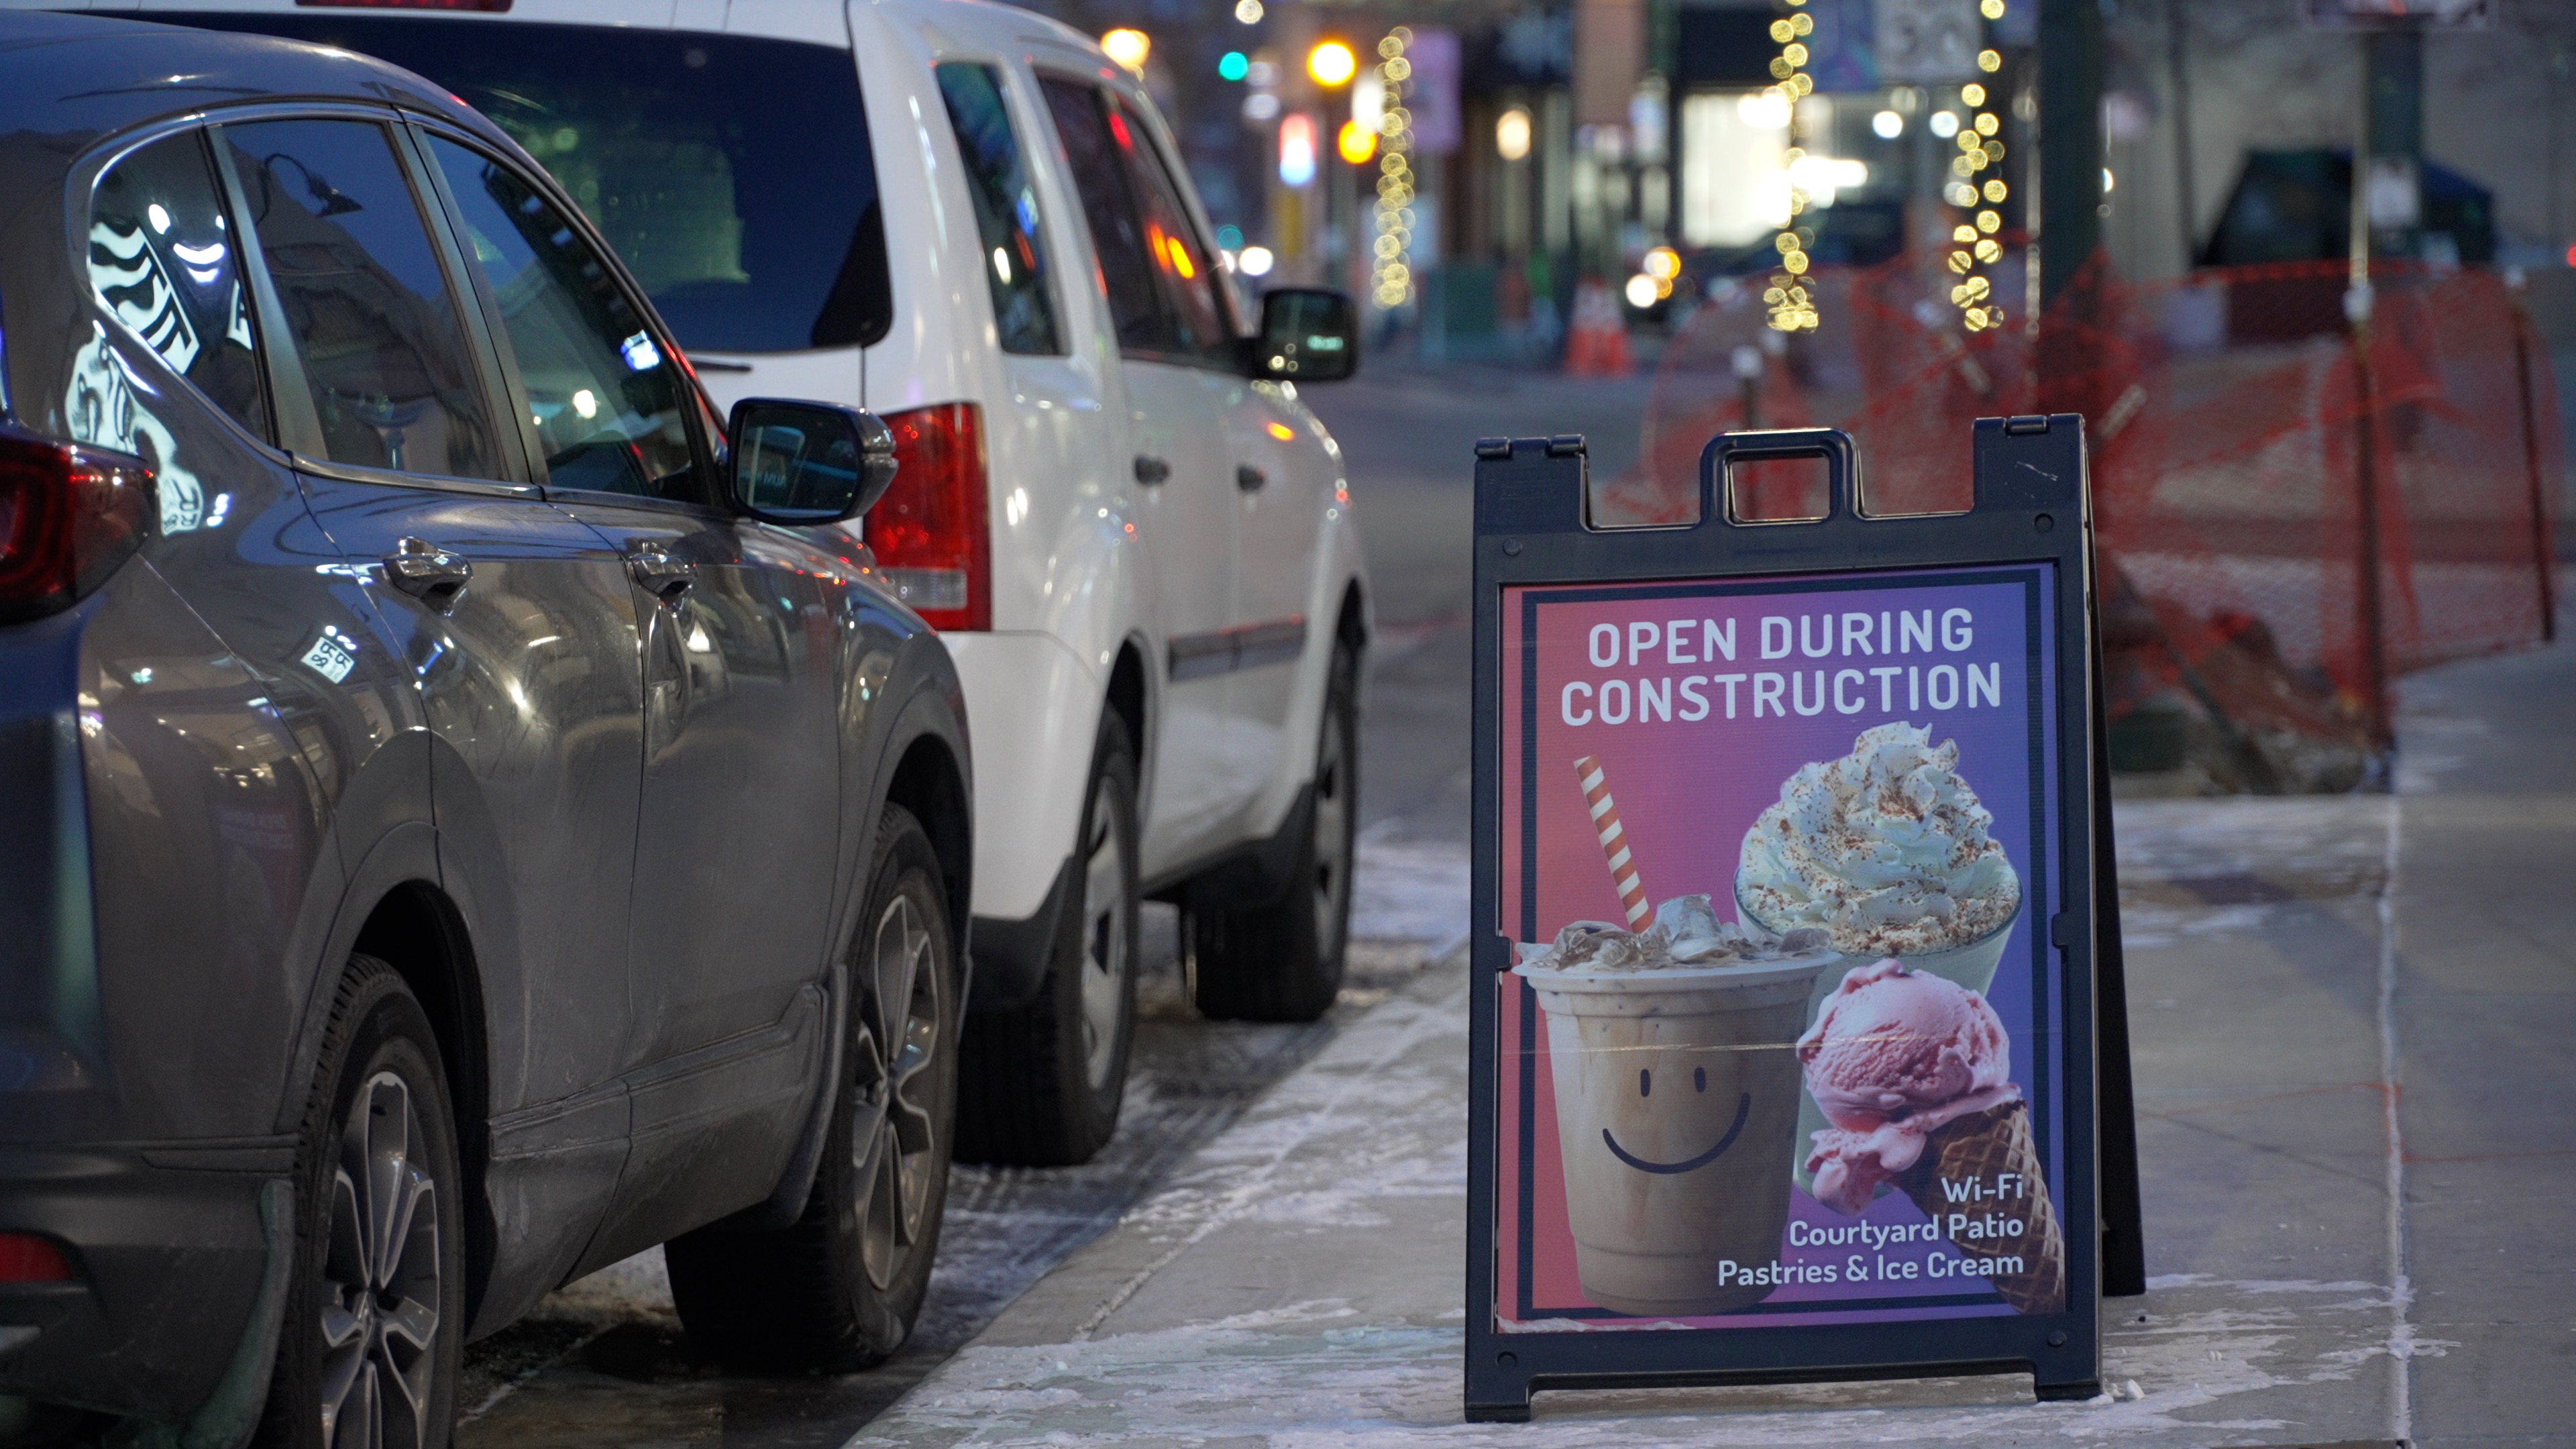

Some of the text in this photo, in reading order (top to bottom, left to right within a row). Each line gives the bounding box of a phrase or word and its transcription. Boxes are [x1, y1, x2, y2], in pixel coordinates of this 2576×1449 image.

[1588, 608, 1973, 667] OPEN DURING
[1561, 661, 2001, 727] CONSTRUCTION
[1941, 1173, 2023, 1203] Wi-Fi
[1789, 1213, 2023, 1250] Courtyard Patio
[1718, 1252, 2023, 1286] Pastries & Ice Cream
